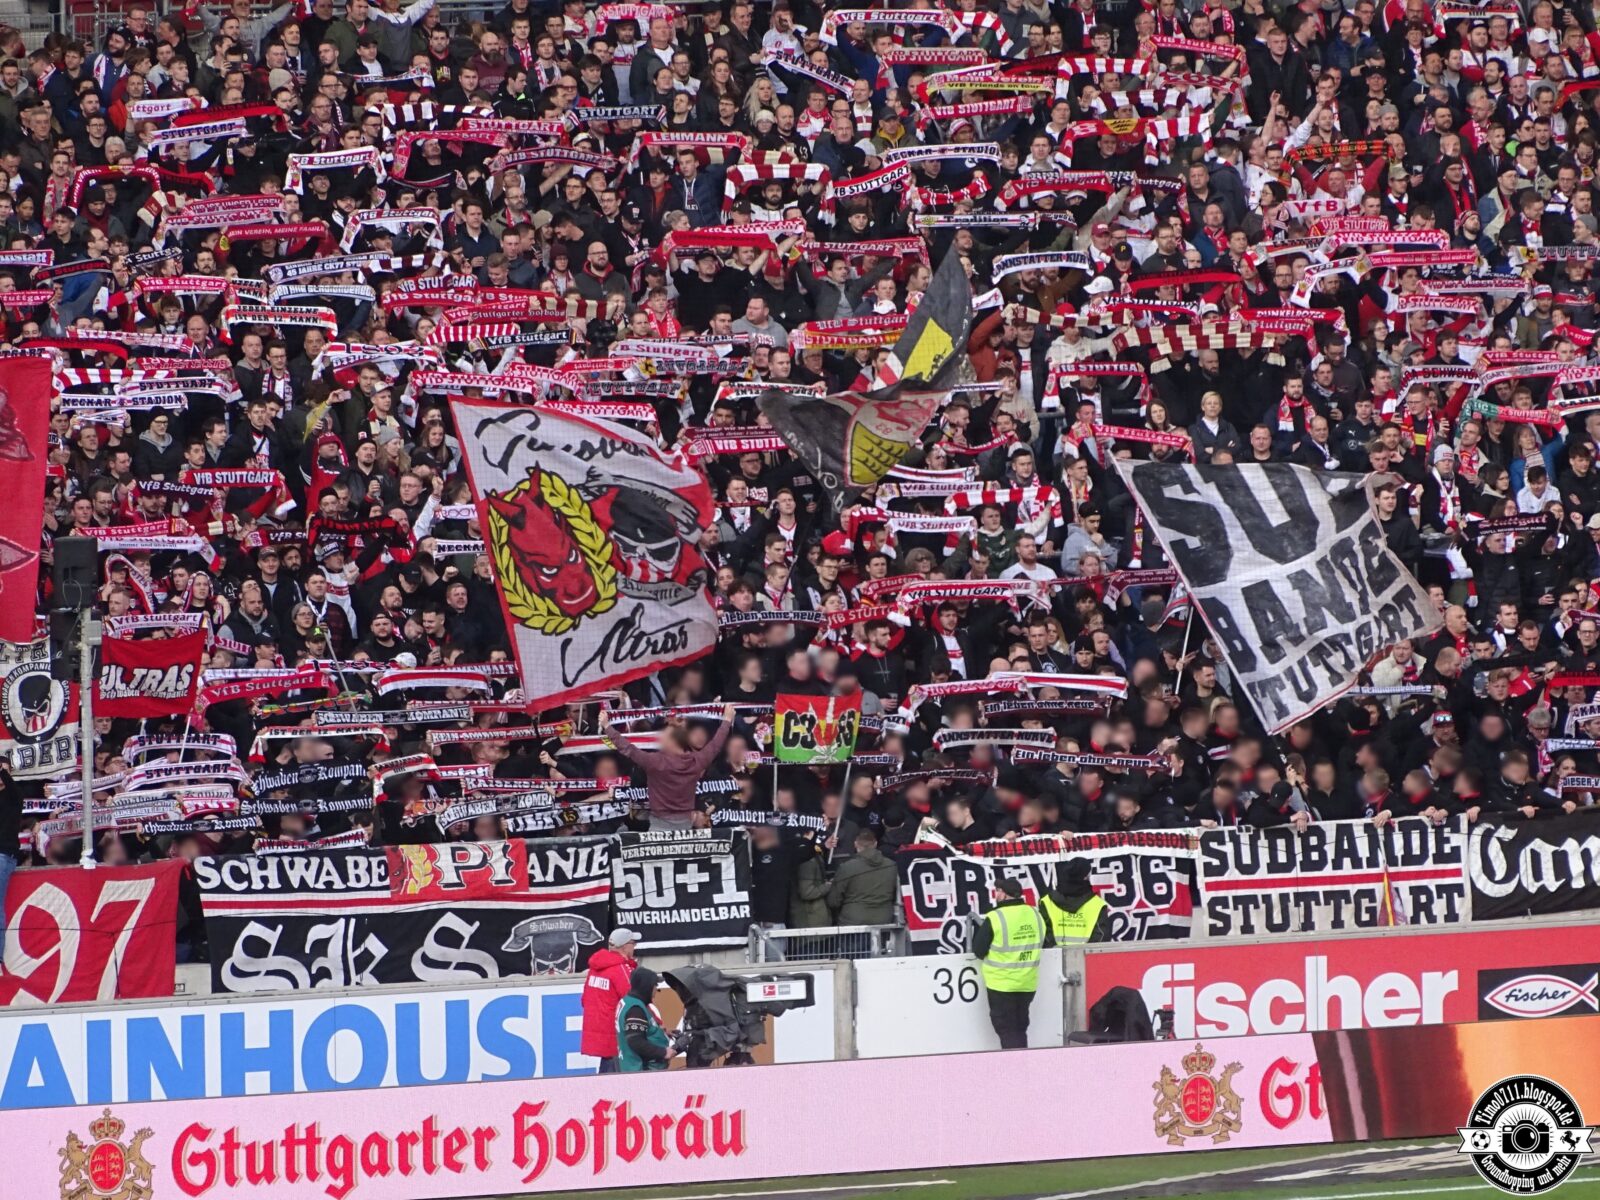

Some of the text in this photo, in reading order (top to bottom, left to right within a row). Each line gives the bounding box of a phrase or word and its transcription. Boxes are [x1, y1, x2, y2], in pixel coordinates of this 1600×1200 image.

[870, 12, 937, 23] Stuttgart
[776, 49, 850, 86] STUTTGART
[580, 106, 657, 119] STUTTGART
[958, 99, 1016, 113] STUTTGART
[161, 122, 236, 140] STUTTGART
[468, 119, 562, 133] STUTTGART
[652, 132, 728, 144] LEHMANN
[1138, 177, 1182, 190] tuttgart
[1294, 200, 1339, 213] VfB
[823, 241, 894, 252] STUTTGART
[167, 279, 228, 289] Stuttgart
[236, 304, 320, 315] JEDER EINZELNE
[235, 314, 249, 322] IST
[487, 331, 568, 345] VfB Stuttgart
[1079, 363, 1138, 372] STUTTGA
[140, 378, 217, 392] STUTTGART
[61, 394, 184, 407] NECKAR STADION
[715, 438, 738, 450] VfB
[194, 471, 275, 488] VfB STUTTGART
[139, 480, 215, 496] VfB Stuttgart
[903, 483, 981, 492] VfB Stuttgart
[111, 522, 169, 536] Stuttgart
[935, 586, 1010, 598] STUTTGART
[114, 613, 198, 625] VfB Stuttgart
[101, 664, 194, 693] ULTRAS
[211, 674, 314, 697] VfB Stuttgart
[269, 728, 287, 736] IST
[432, 730, 459, 745] KEIN
[137, 733, 221, 747] STUTTGART
[1038, 750, 1076, 763] leben
[1079, 754, 1113, 764] ohne
[145, 763, 231, 779] STUTTGART
[467, 776, 597, 790] KAISERSLAUTERN
[517, 793, 554, 807] KOMPA
[614, 788, 649, 801] Schwa
[240, 798, 298, 815] Schwaben
[639, 828, 712, 843] EHRE ALLEN
[1099, 830, 1191, 852] REPRESSION
[622, 842, 731, 860] VERSTORBENEN ULTRAS
[1200, 818, 1462, 879] SÜDBANDE
[526, 843, 612, 884] ANIE
[194, 855, 392, 892] SCHWABE
[612, 854, 750, 909] 50+1
[1100, 853, 1177, 910] 36
[616, 904, 751, 926] UNVERHANDELBAR
[1207, 883, 1465, 937] STUTTGRT
[529, 919, 575, 933] Schwaben
[3, 876, 157, 1004] 97
[932, 965, 980, 1004] 36
[1140, 955, 1460, 1041] fischer
[1504, 986, 1572, 1004] fischer
[170, 1094, 748, 1200] Stuttgarter Hofbräu
